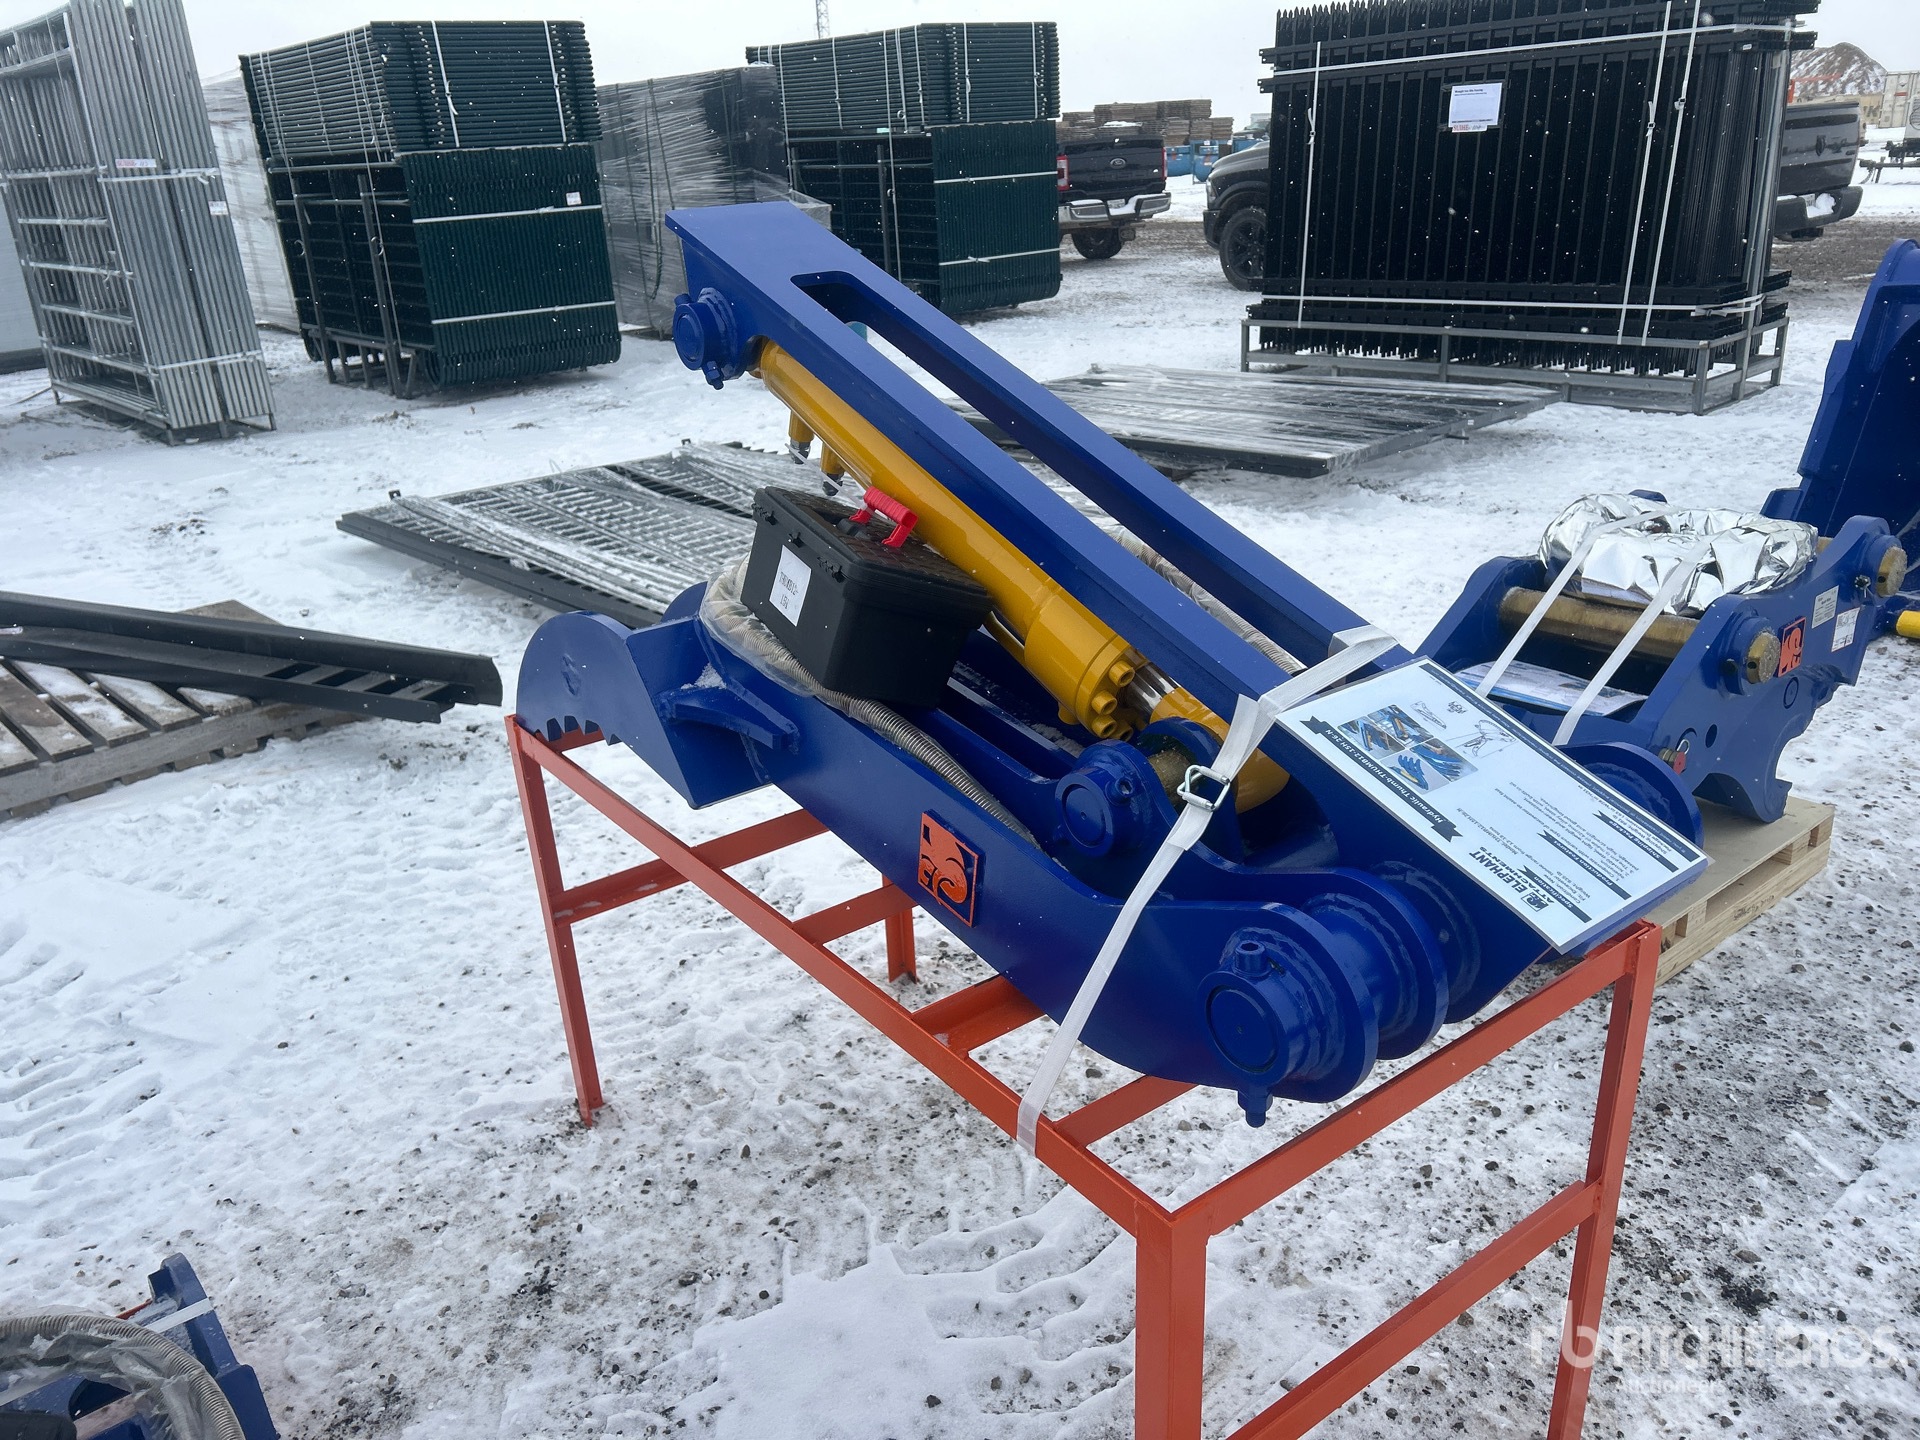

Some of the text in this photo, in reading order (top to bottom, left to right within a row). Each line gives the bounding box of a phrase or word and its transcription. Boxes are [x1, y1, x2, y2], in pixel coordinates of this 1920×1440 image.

[1324, 729, 1444, 822] Hydraulic Thumb-THUMB12-15H 26-N
[1531, 798, 1543, 806] with
[1521, 807, 1545, 825] excavator
[1555, 815, 1568, 824] alloy
[1563, 815, 1577, 825] good
[1548, 827, 1562, 837] type
[1564, 827, 1582, 841] weight
[1575, 824, 1586, 832] and
[1624, 817, 1651, 837] Dimension:
[1627, 825, 1646, 838] Weight:
[1559, 836, 1578, 850] various
[1580, 839, 1594, 849] light
[1585, 831, 1606, 846] strength
[1607, 819, 1661, 858] Shipping Package
[1644, 837, 1667, 854] Shipping
[1650, 836, 1672, 851] Package
[1512, 844, 1525, 854] from
[1589, 840, 1605, 852] made
[1605, 845, 1618, 855] high
[1524, 853, 1539, 864] range
[1576, 849, 1590, 858] with
[1608, 854, 1619, 862] pin
[1552, 839, 1613, 885] Production Features
[1588, 857, 1615, 877] Cooperate
[1617, 861, 1628, 869] The
[1469, 851, 1527, 893] ELEPHANT
[1480, 847, 1554, 904] ATTACHMENTS
[1542, 873, 1581, 903] Condition: New
[1552, 874, 1577, 894] Excavator
[1570, 882, 1591, 898] Weight:
[1532, 875, 1574, 908] Specification
